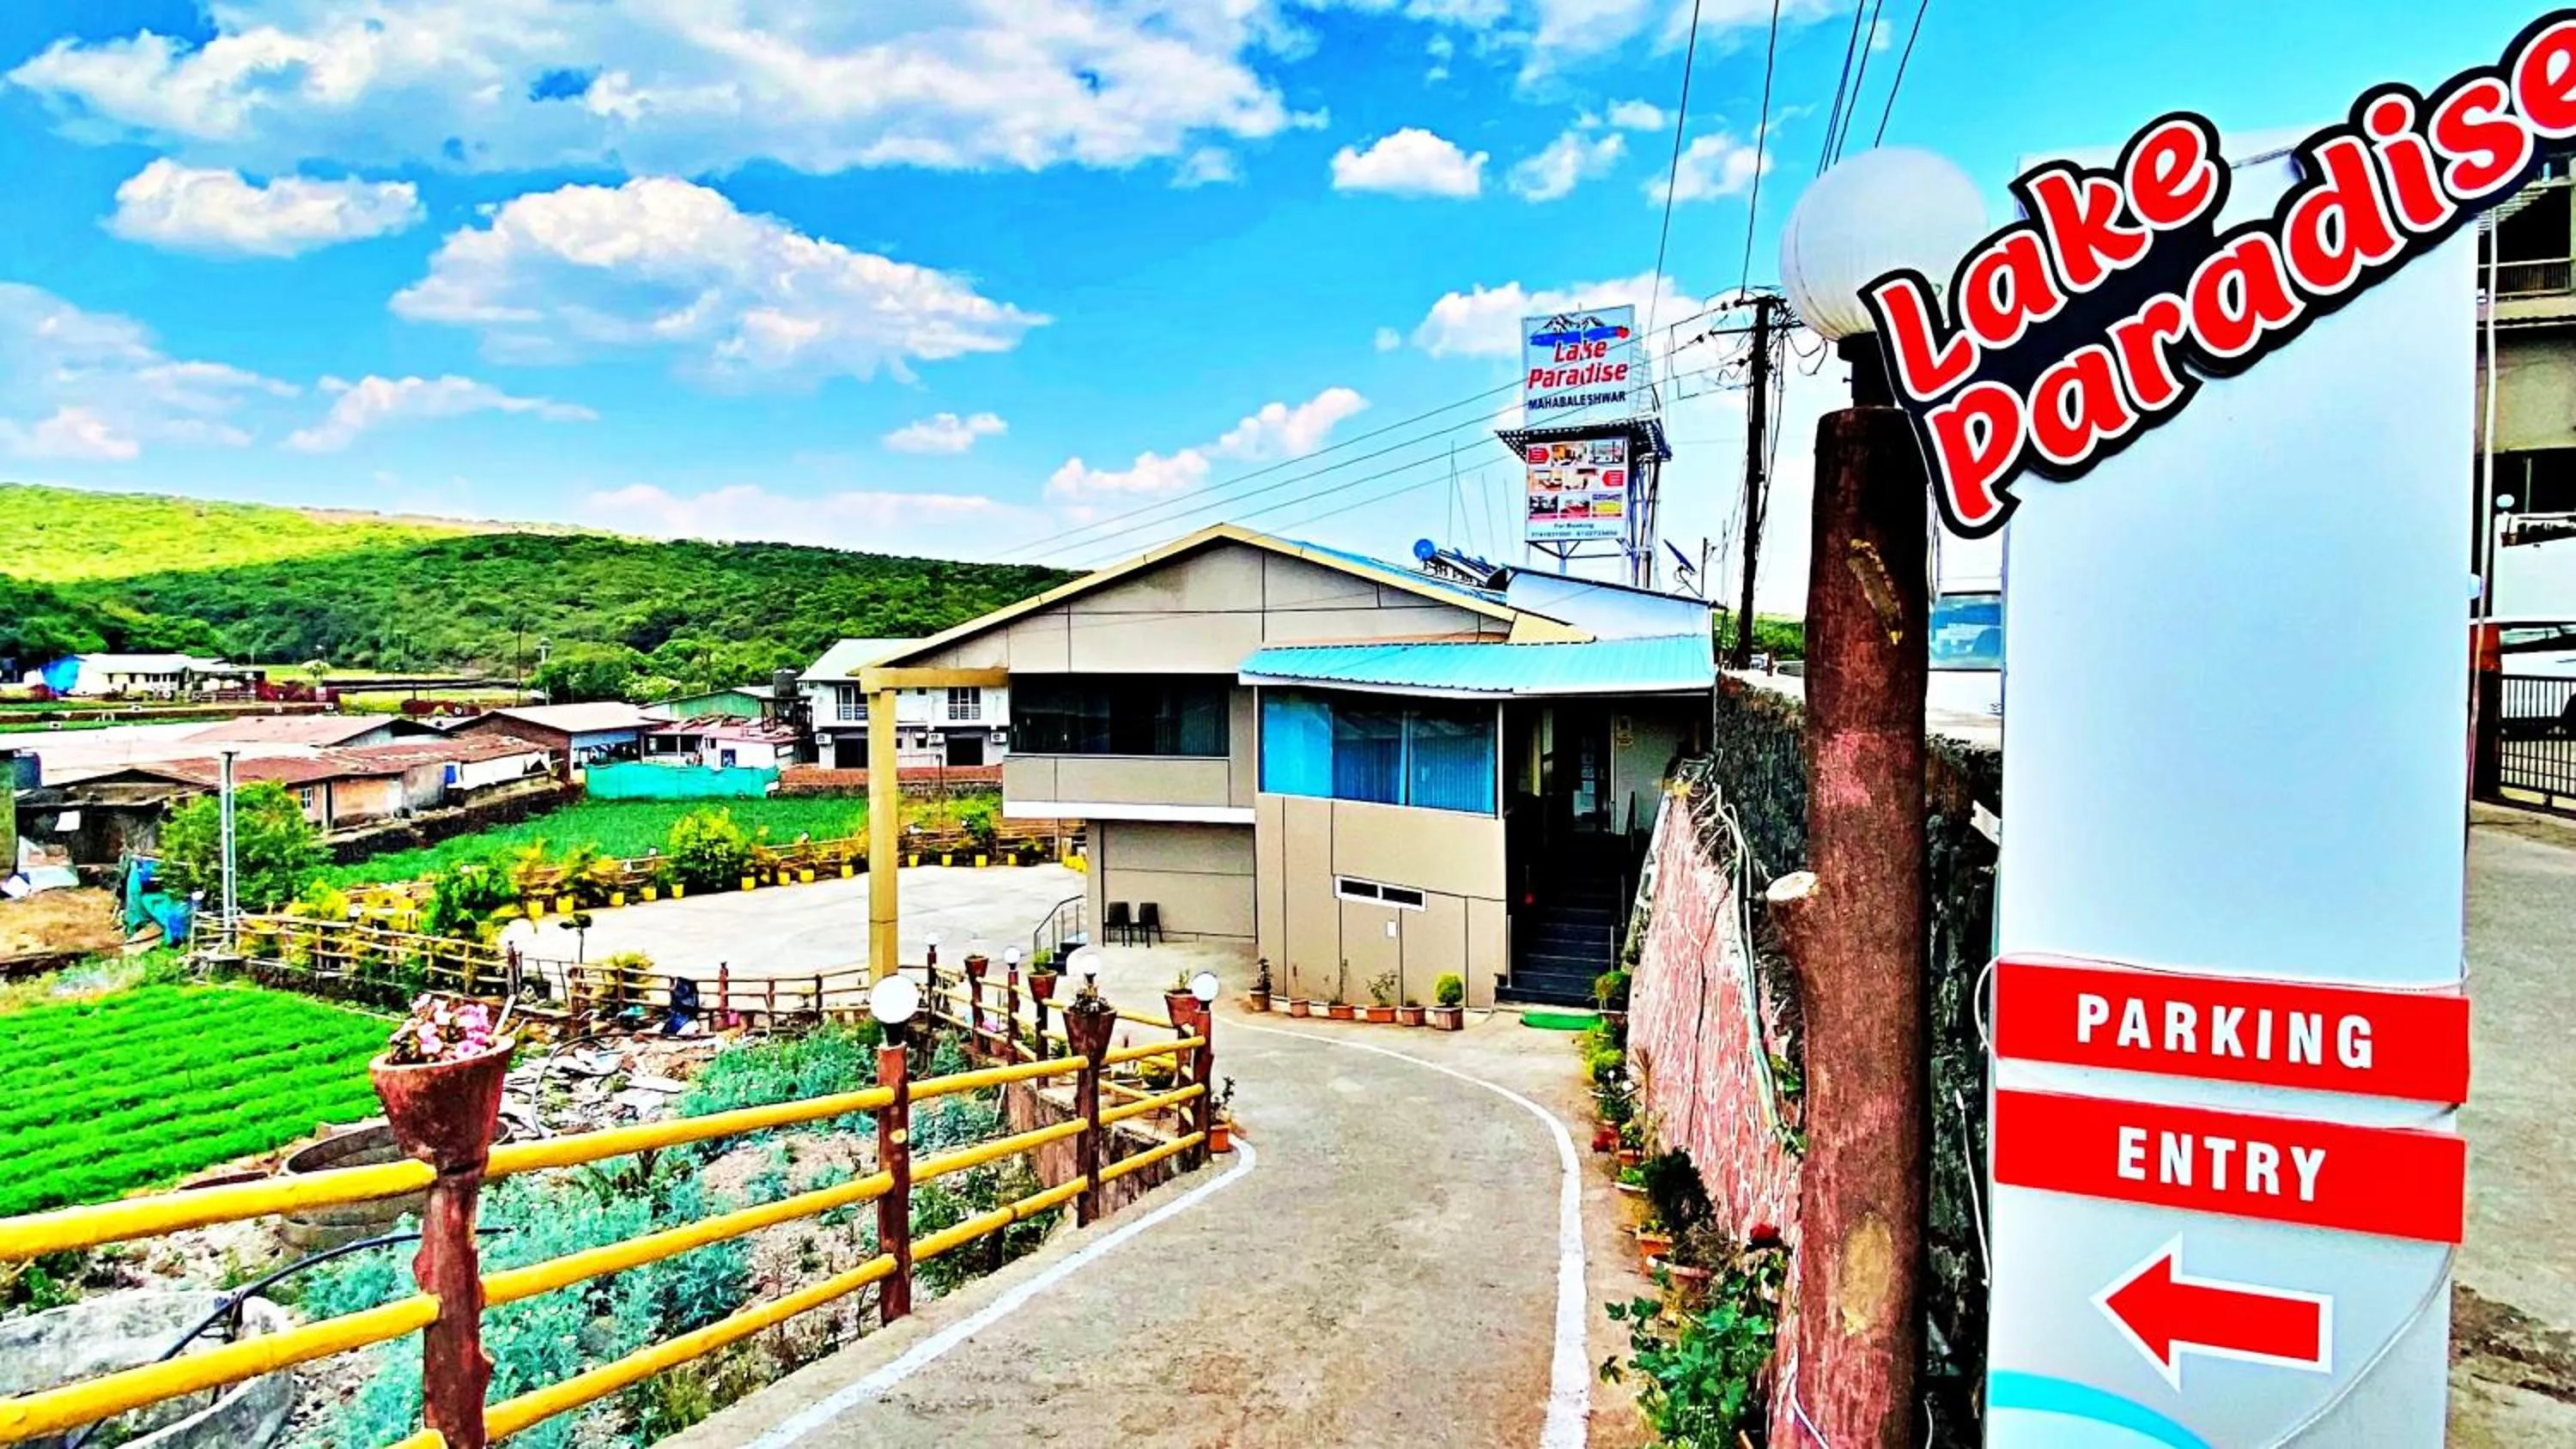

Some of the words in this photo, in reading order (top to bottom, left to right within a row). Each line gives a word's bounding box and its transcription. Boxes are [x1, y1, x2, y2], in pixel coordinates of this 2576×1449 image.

[1872, 118, 2220, 403] Lake
[1925, 19, 2576, 528] Paradise
[1528, 363, 1628, 390] Paradise
[1553, 341, 1607, 362] Lake
[1528, 391, 1626, 410] MAHABALESHWAR
[2076, 992, 2374, 1069] PARKING
[2117, 1125, 2327, 1202] ENTRY
